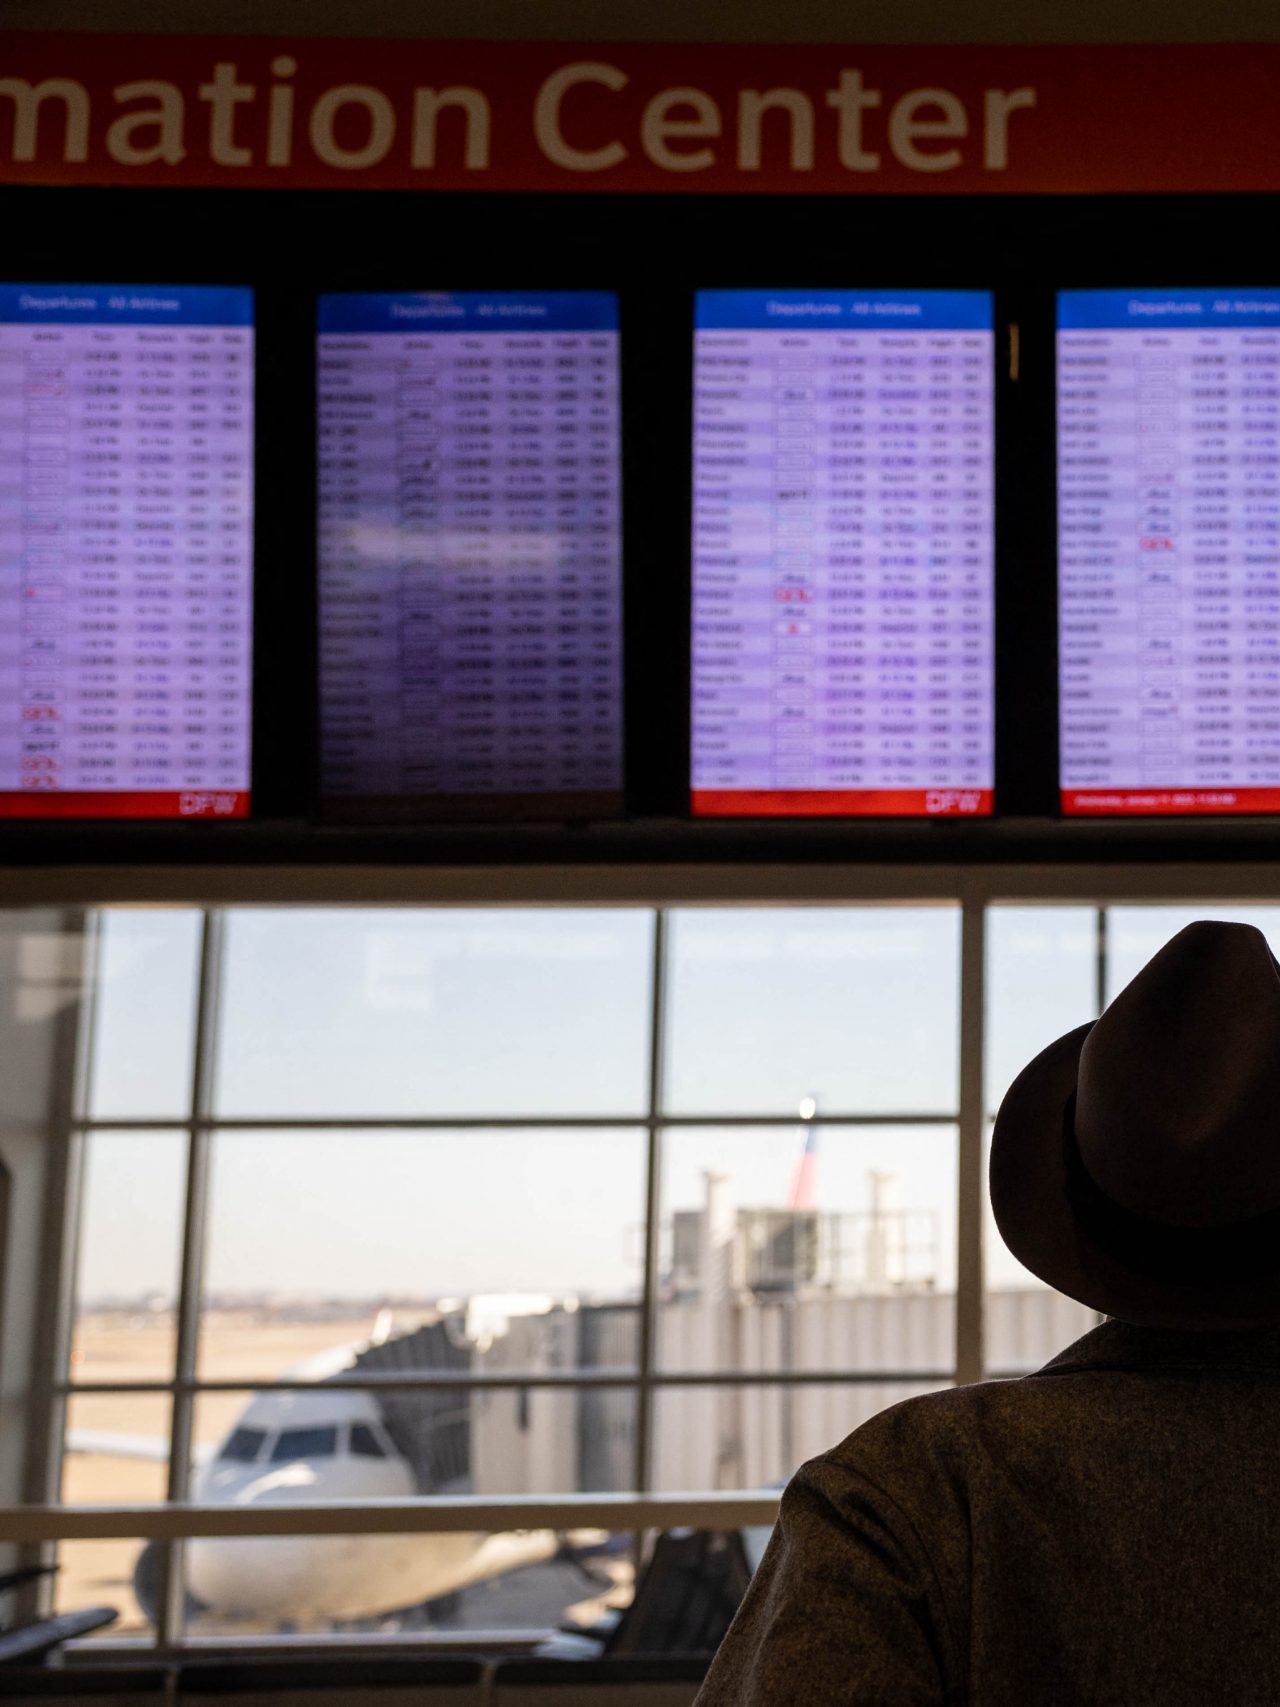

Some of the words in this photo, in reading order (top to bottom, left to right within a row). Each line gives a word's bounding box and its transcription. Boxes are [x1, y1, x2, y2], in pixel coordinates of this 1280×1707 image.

[533, 61, 1037, 172] Center
[20, 295, 96, 311] Departures
[767, 302, 841, 316] Departures
[1129, 299, 1201, 314] Departures
[180, 793, 237, 815] DFW
[925, 790, 981, 812] DFW
